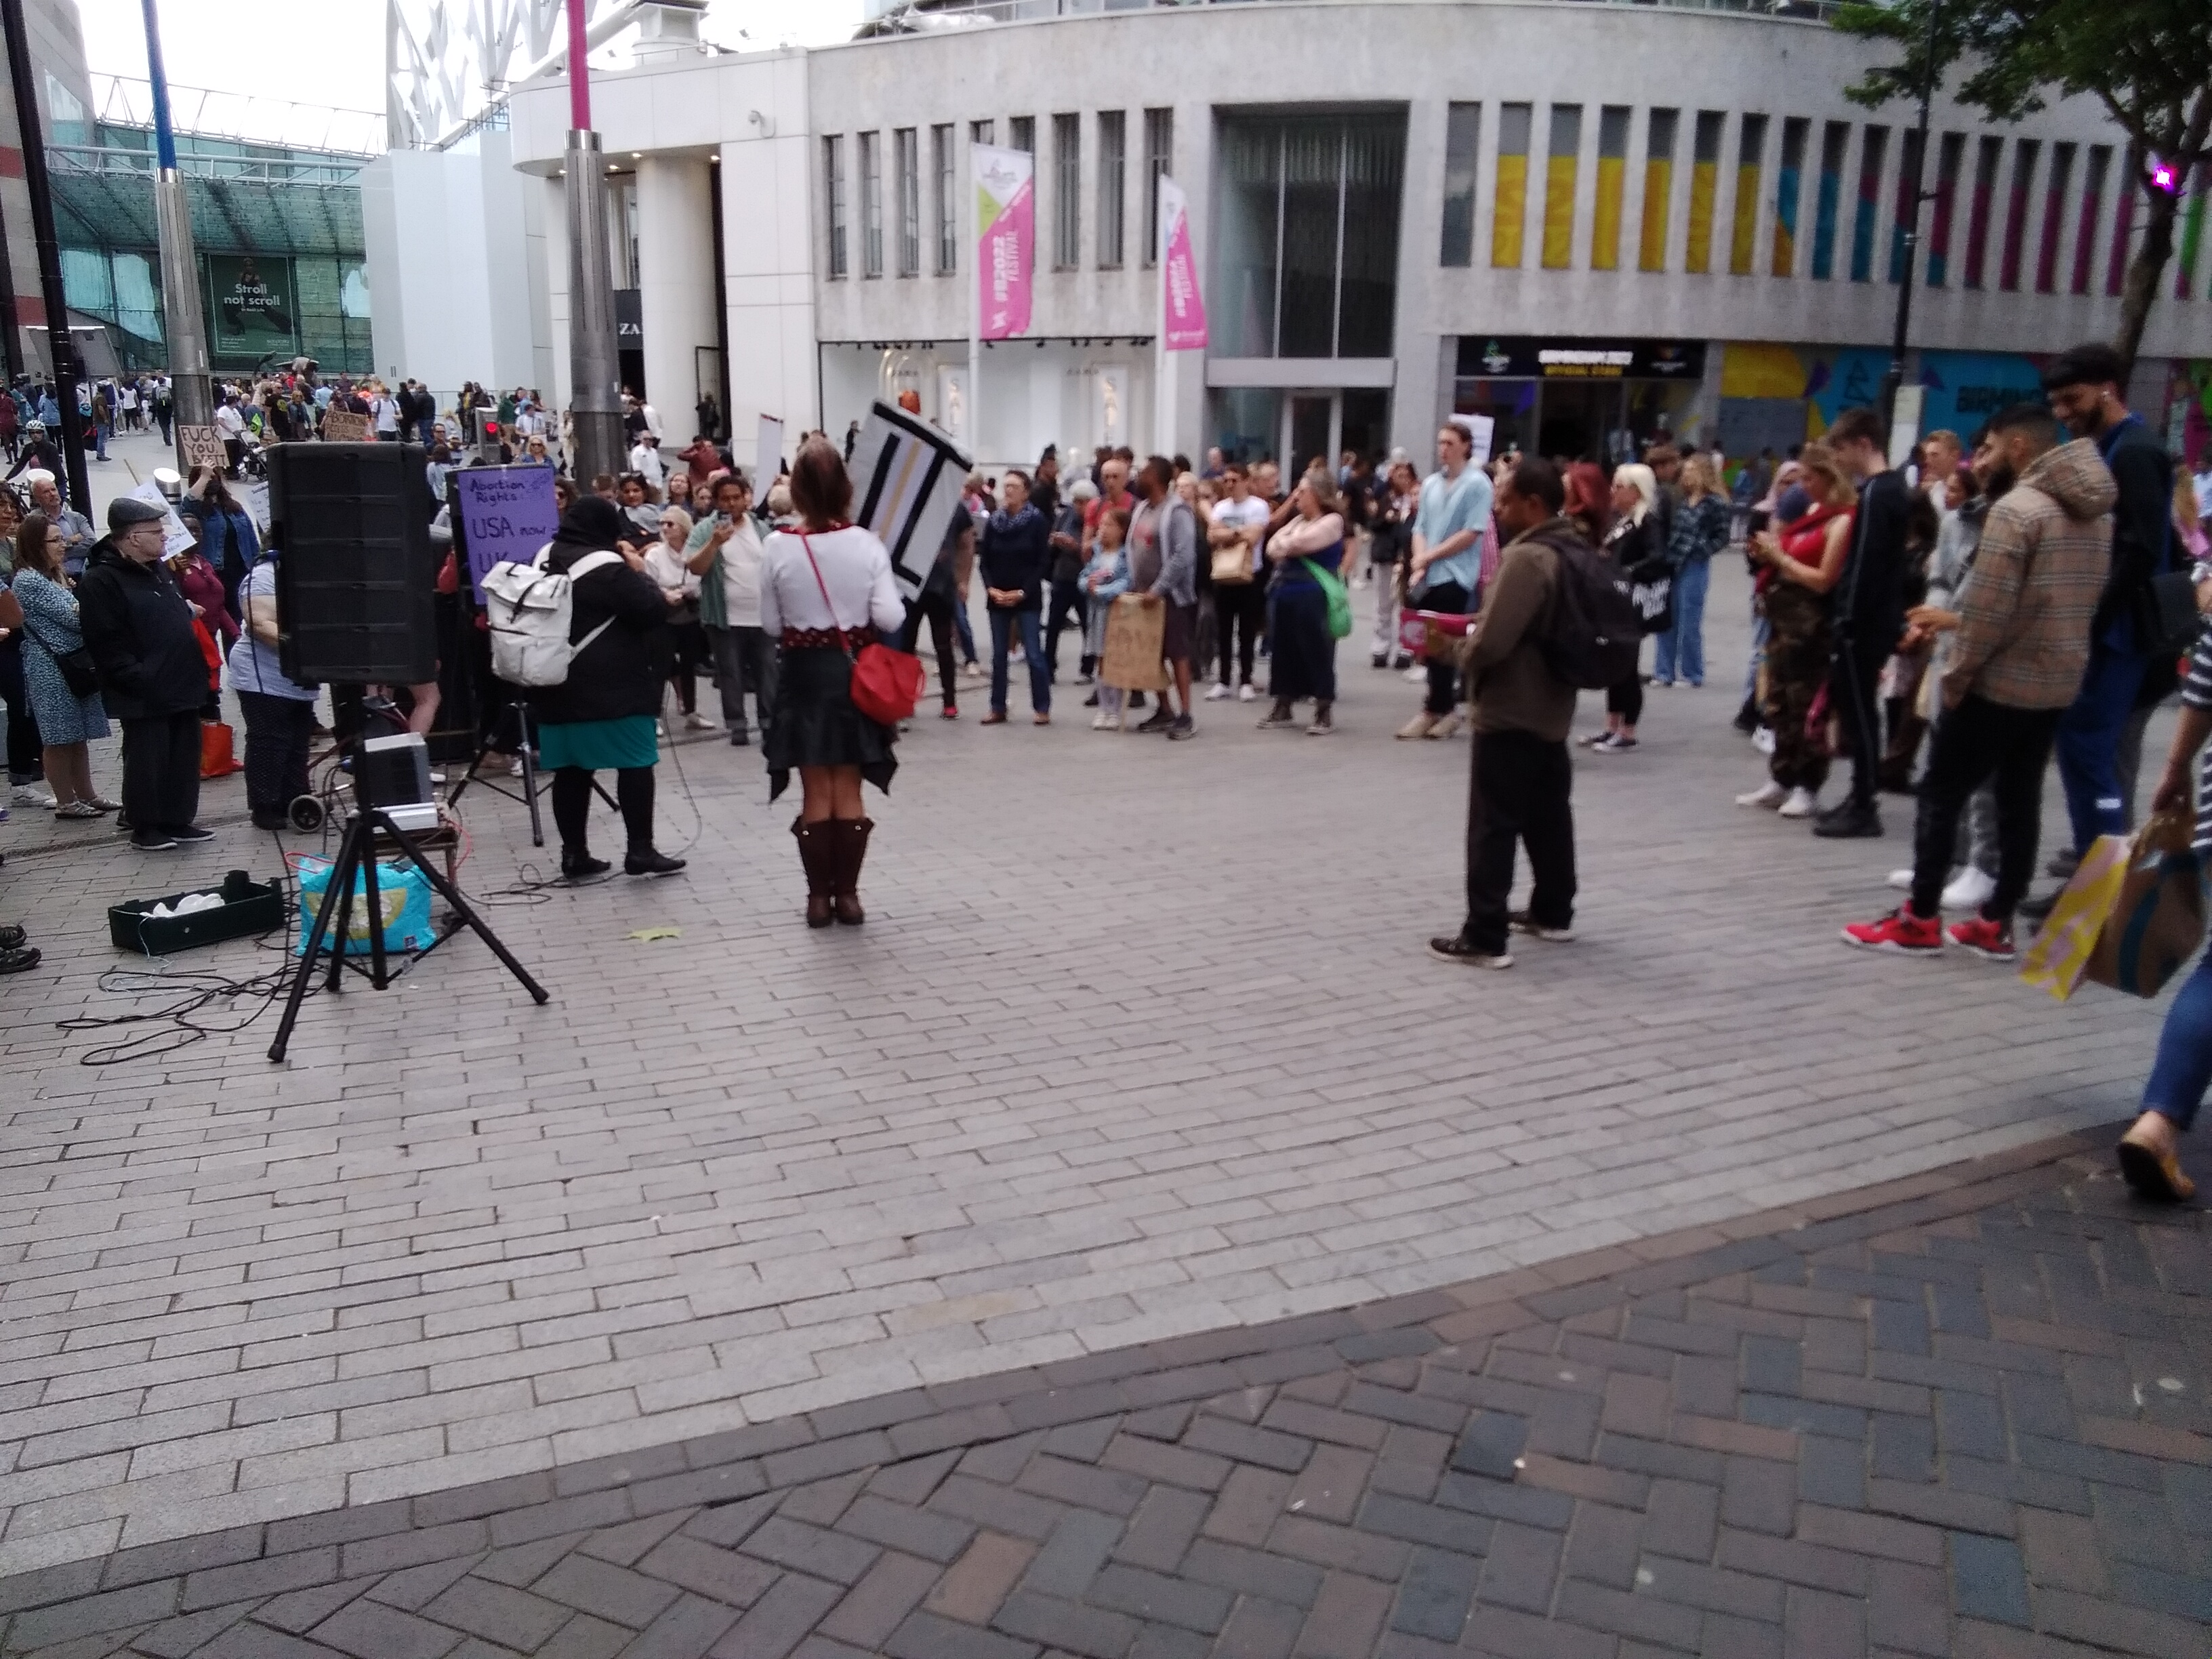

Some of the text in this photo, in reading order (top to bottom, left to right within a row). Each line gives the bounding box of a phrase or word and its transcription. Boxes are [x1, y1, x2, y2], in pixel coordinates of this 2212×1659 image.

[235, 284, 267, 294] Stroll
[224, 295, 280, 306] not scroll
[180, 427, 221, 443] FUCK
[470, 478, 525, 492] Abortion
[476, 492, 517, 507] Rights
[473, 516, 515, 539] USA
